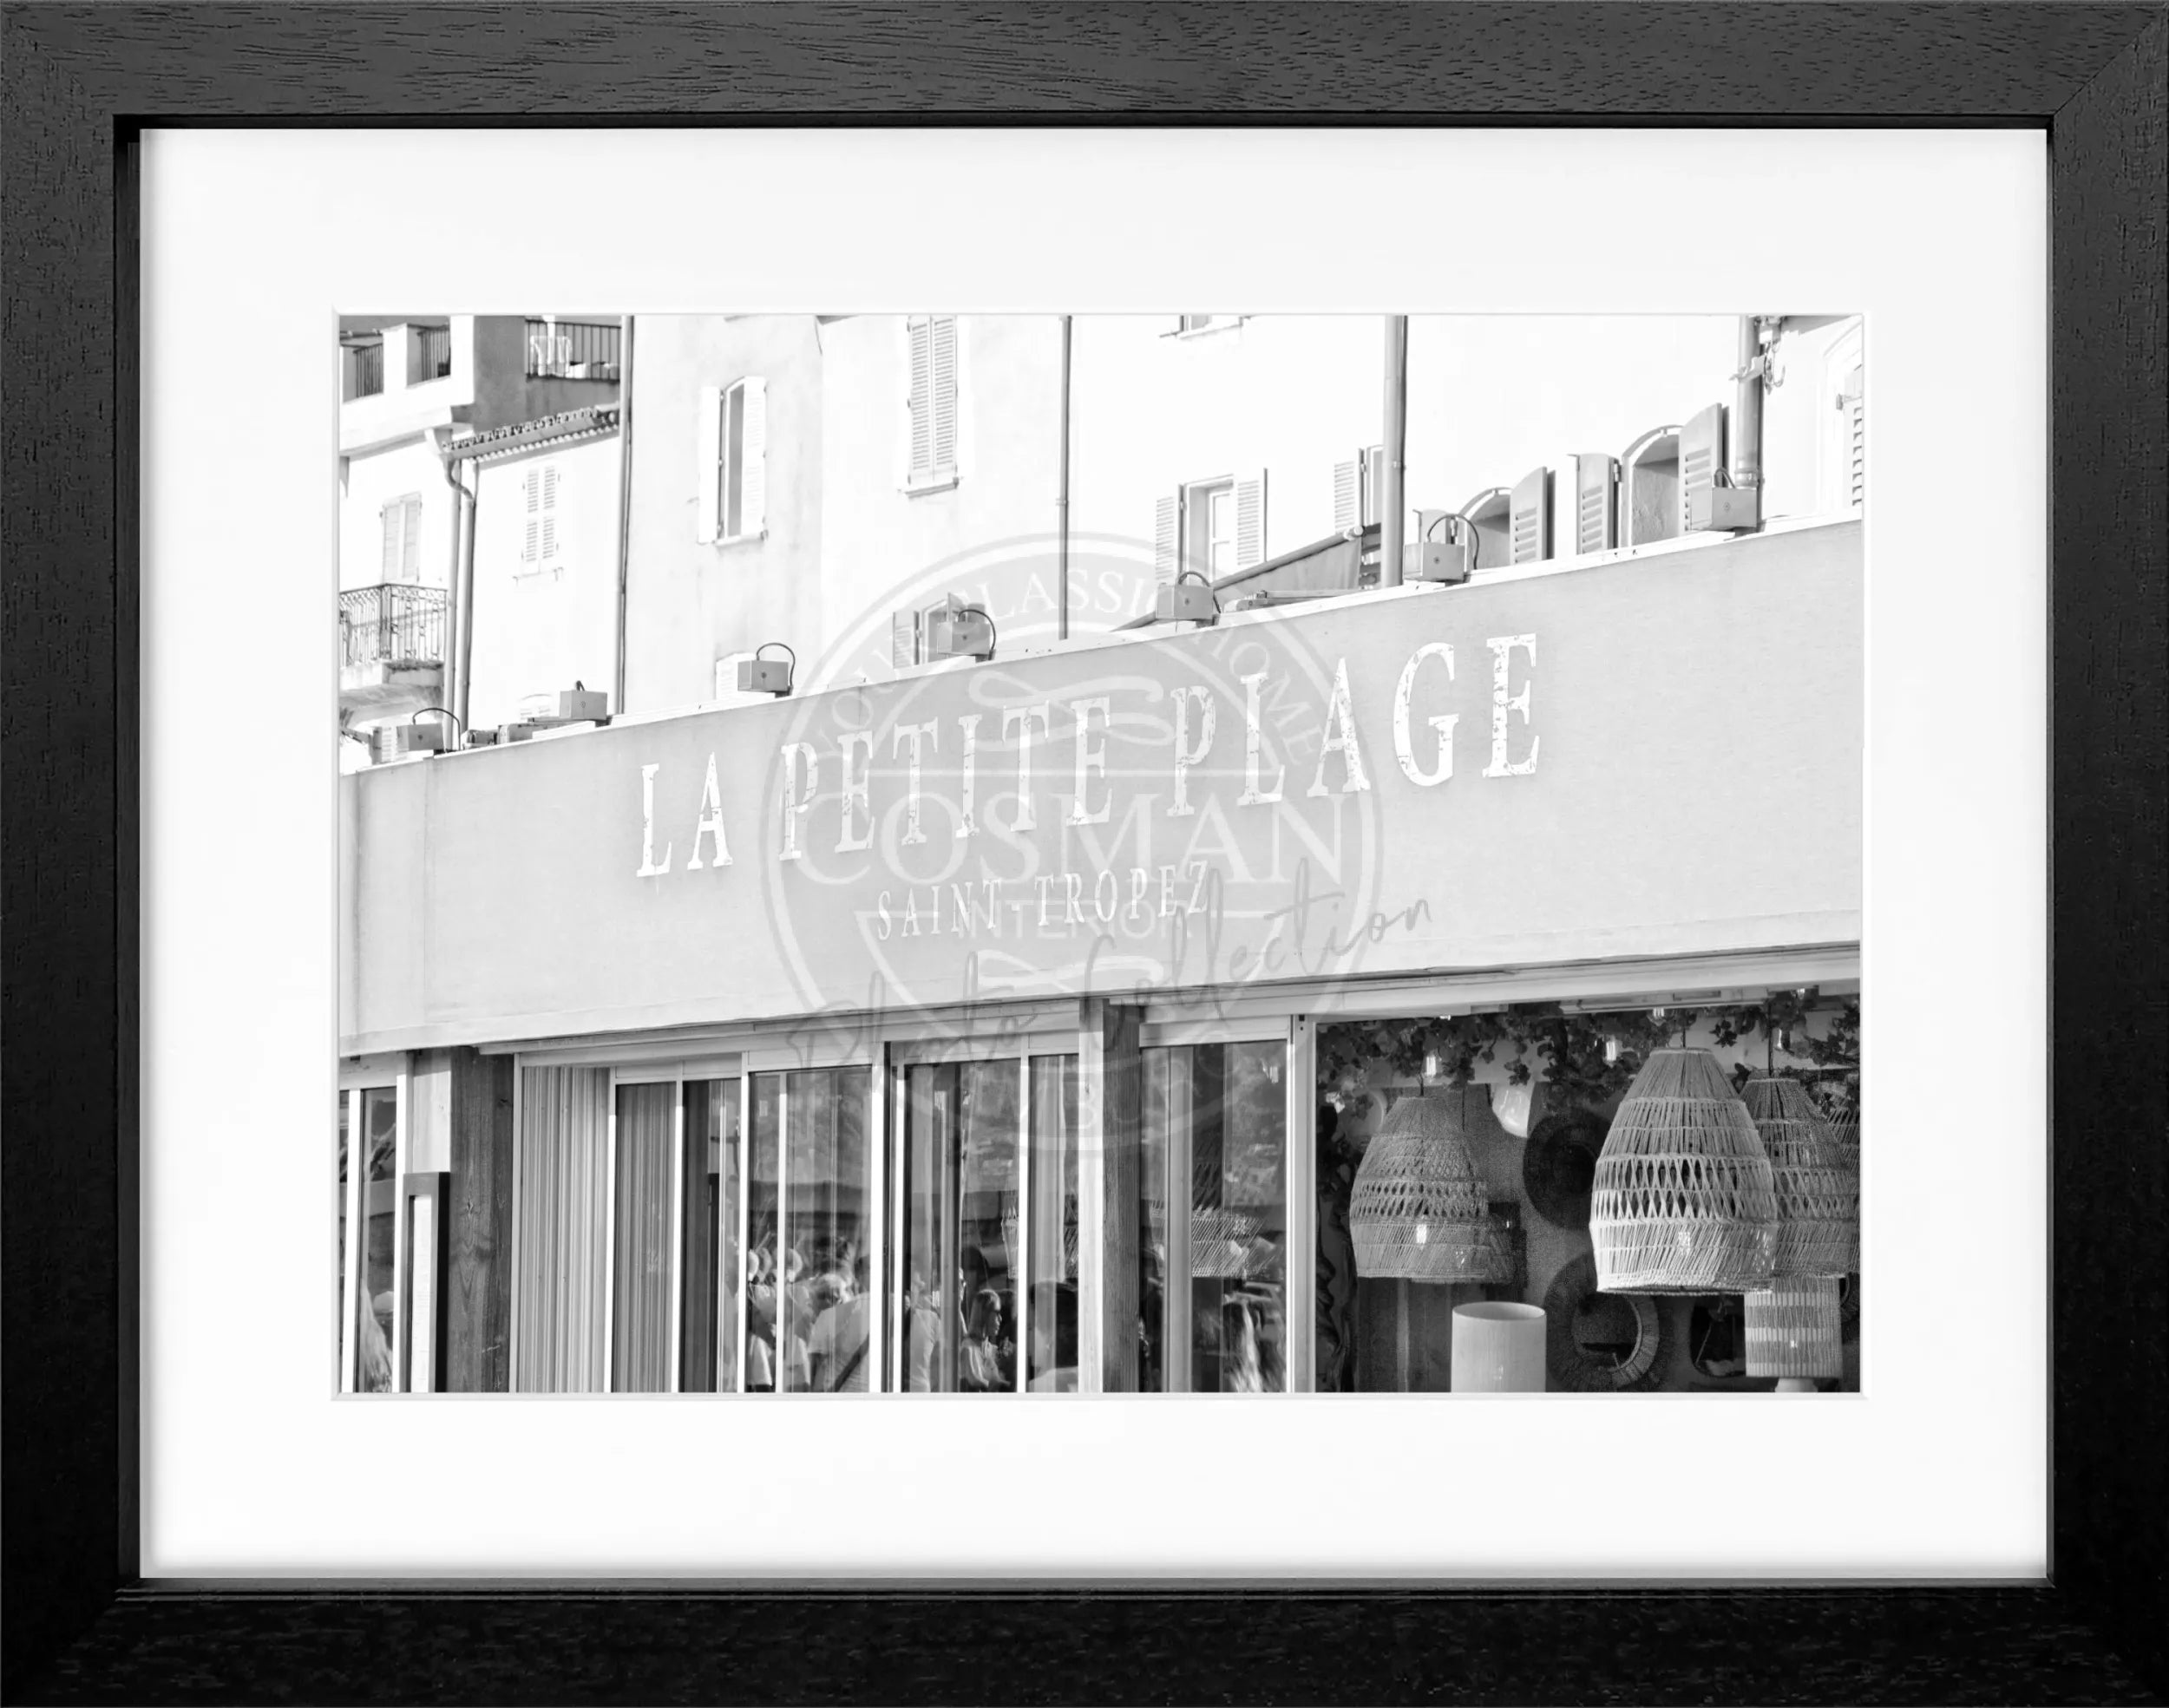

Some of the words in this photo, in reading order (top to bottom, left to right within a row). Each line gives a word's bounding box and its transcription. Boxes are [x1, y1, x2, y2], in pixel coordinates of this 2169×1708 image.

[636, 750, 733, 877] LA
[779, 696, 1111, 861] PETITE
[1166, 633, 1540, 816] PLAGE
[876, 878, 1003, 941] SAINT
[1033, 860, 1212, 926] TROPEZ
